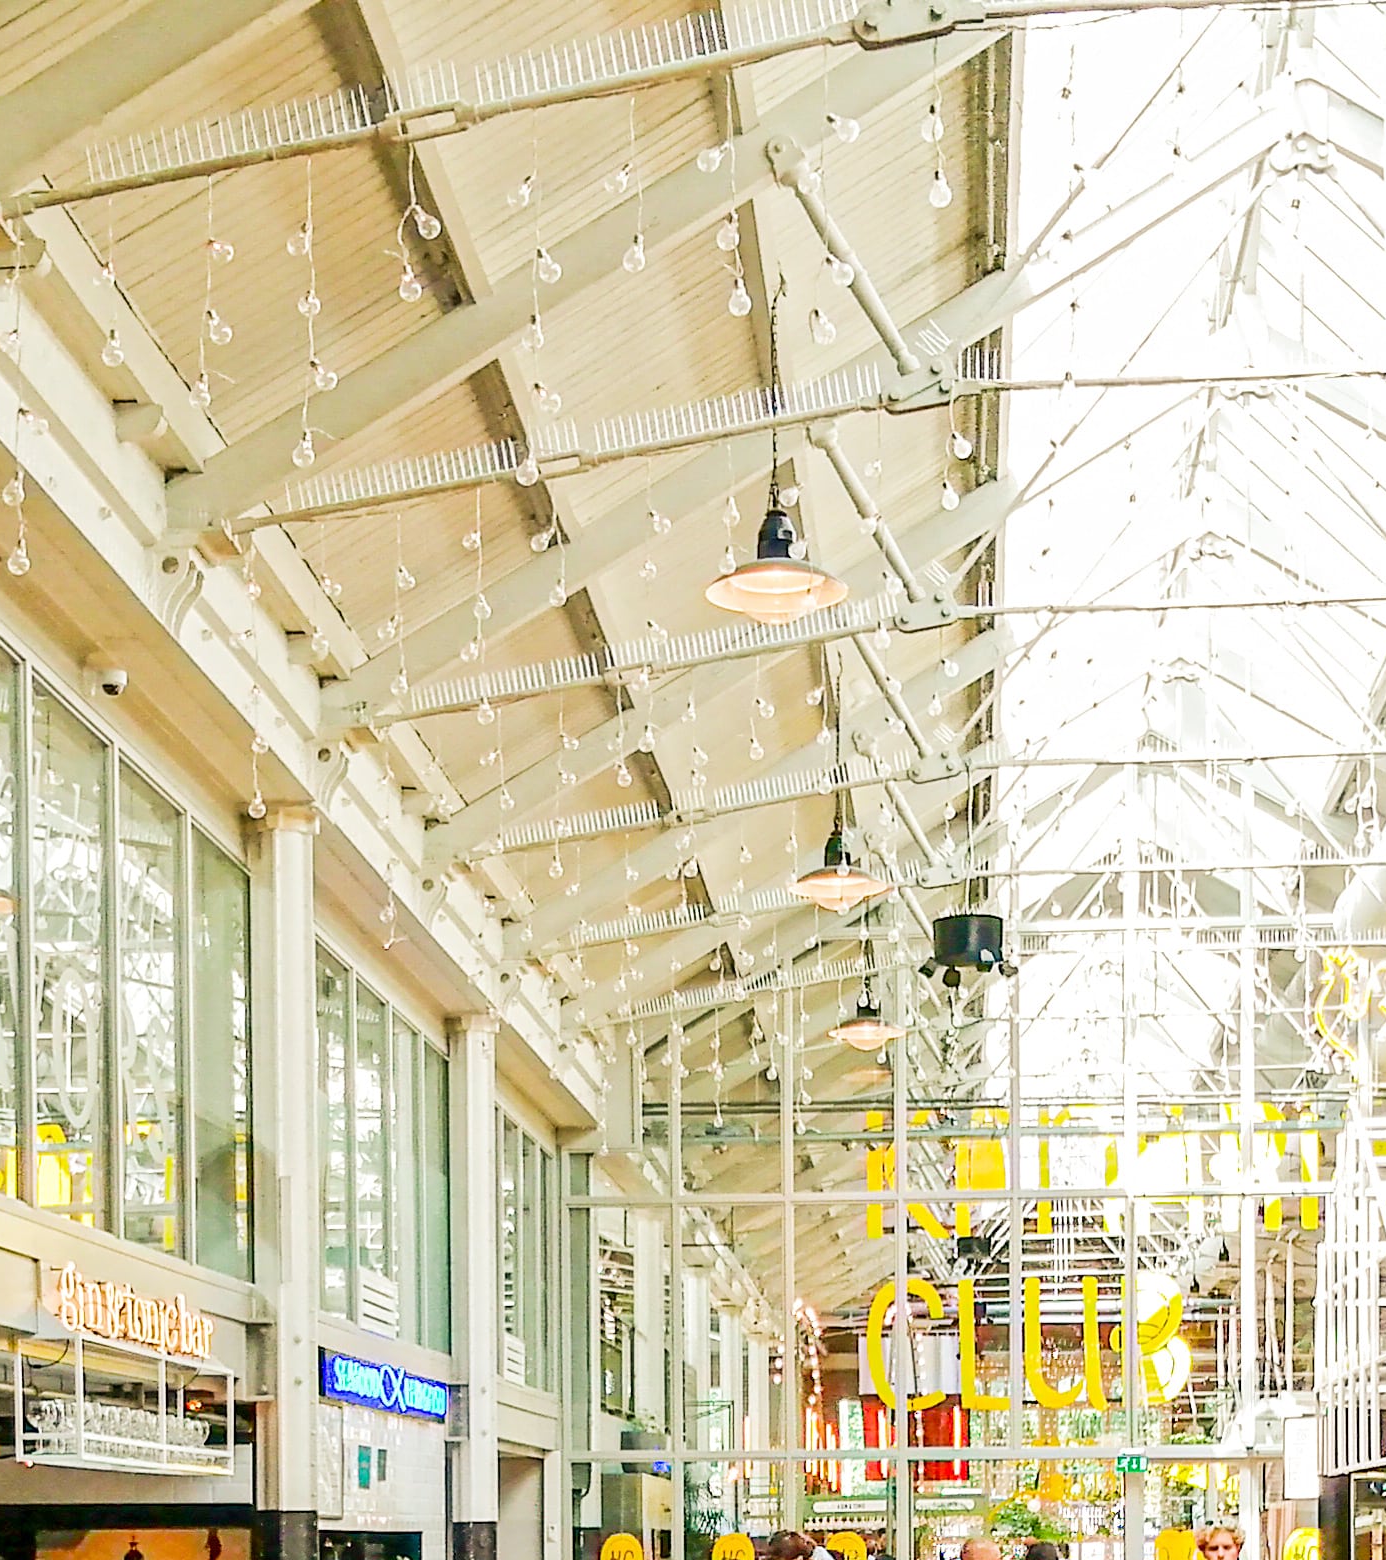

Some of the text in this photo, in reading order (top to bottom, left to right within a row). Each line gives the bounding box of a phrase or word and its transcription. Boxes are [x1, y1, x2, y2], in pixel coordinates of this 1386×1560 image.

[60, 1261, 103, 1332] gin
[123, 1284, 178, 1354] tonic
[176, 1293, 214, 1359] bar
[865, 1273, 1193, 1411] CLUB
